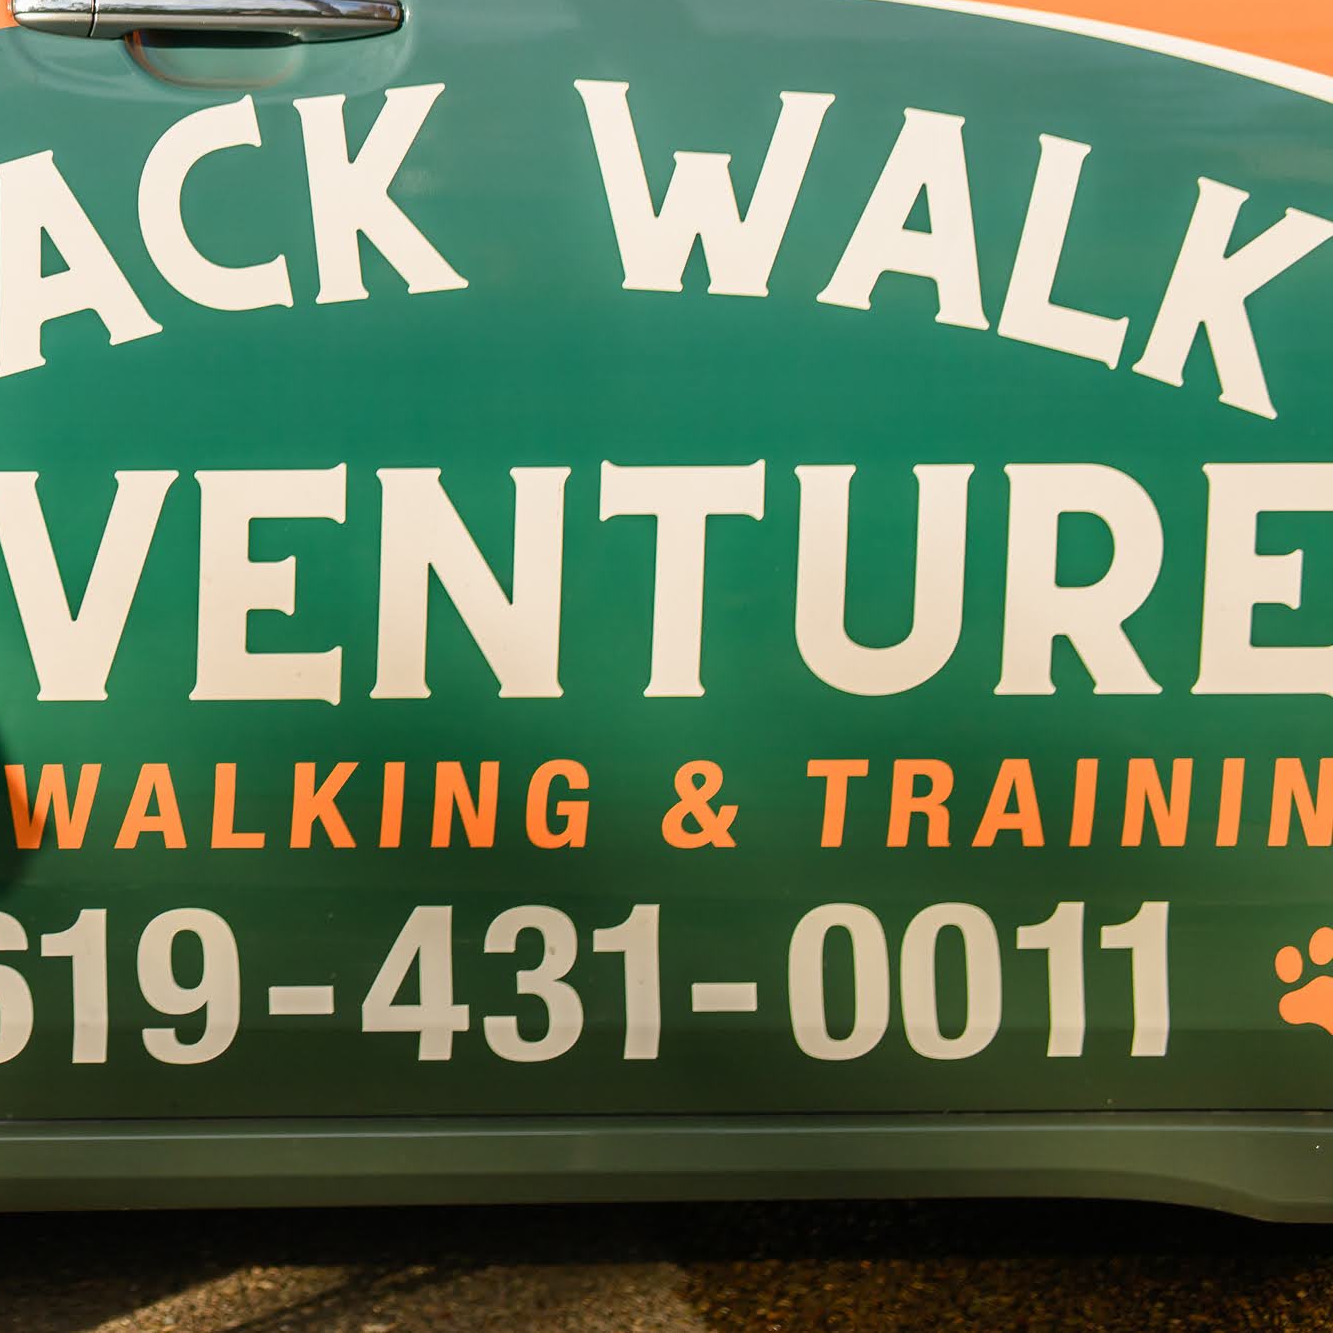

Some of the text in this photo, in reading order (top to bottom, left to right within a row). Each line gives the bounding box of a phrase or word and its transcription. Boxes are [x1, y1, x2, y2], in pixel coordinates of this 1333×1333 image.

[573, 79, 1333, 419] WALK
[4, 758, 593, 850] WALKING
[661, 759, 740, 850] &
[806, 758, 1333, 848] TRAININ
